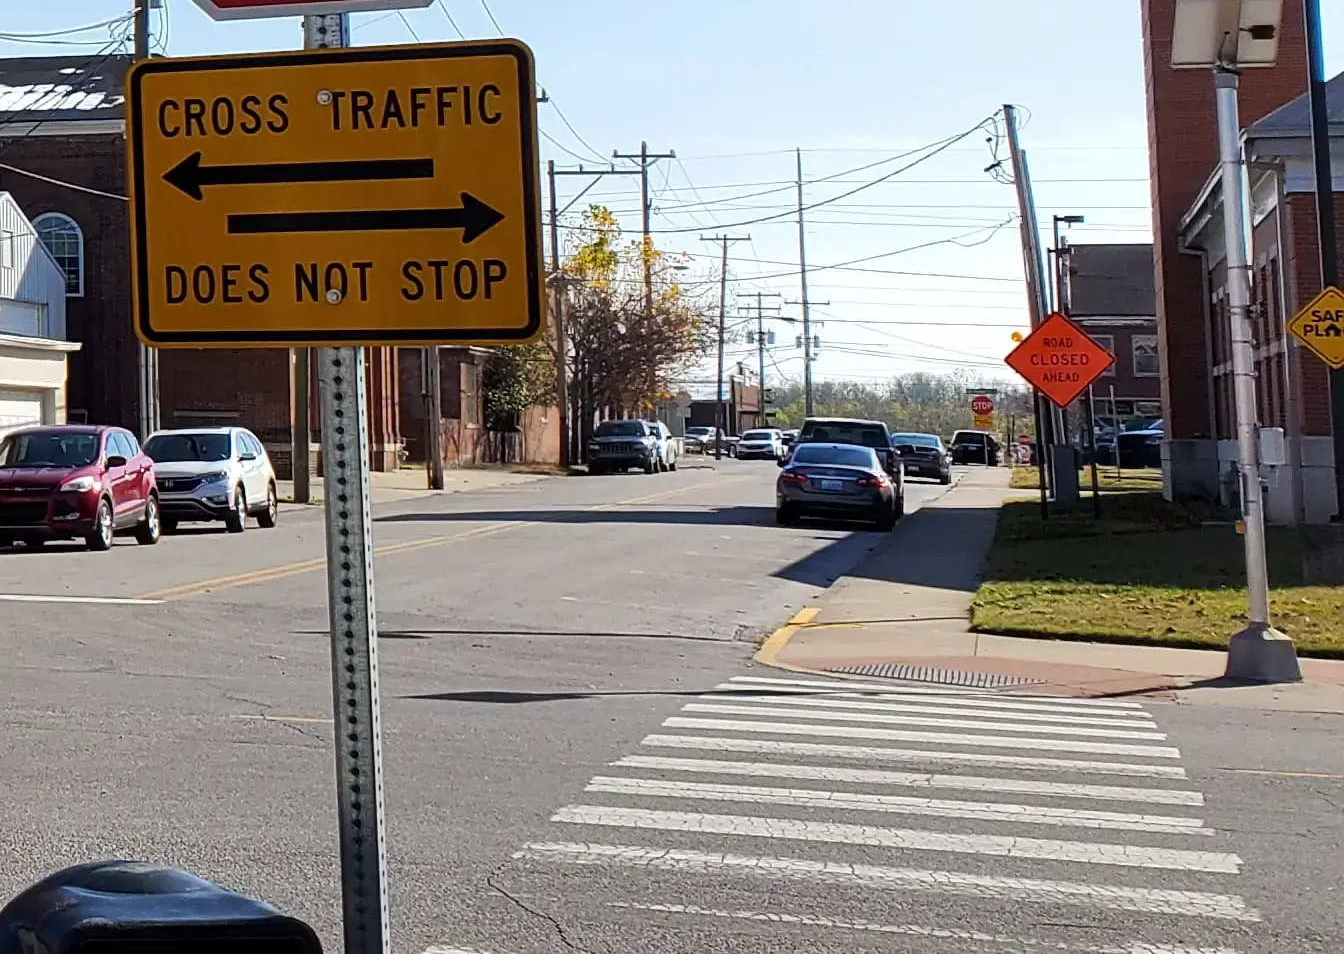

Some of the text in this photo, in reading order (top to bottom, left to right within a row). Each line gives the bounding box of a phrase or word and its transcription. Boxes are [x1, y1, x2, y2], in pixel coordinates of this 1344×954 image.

[158, 84, 503, 138] CROSS TRAFFIC
[165, 259, 508, 304] DOES NOT STOP
[1312, 310, 1344, 322] SAF
[1043, 337, 1073, 349] ROAD
[1030, 353, 1090, 366] CLOSED
[1042, 372, 1080, 383] AHEAD
[972, 401, 993, 411] STOP
